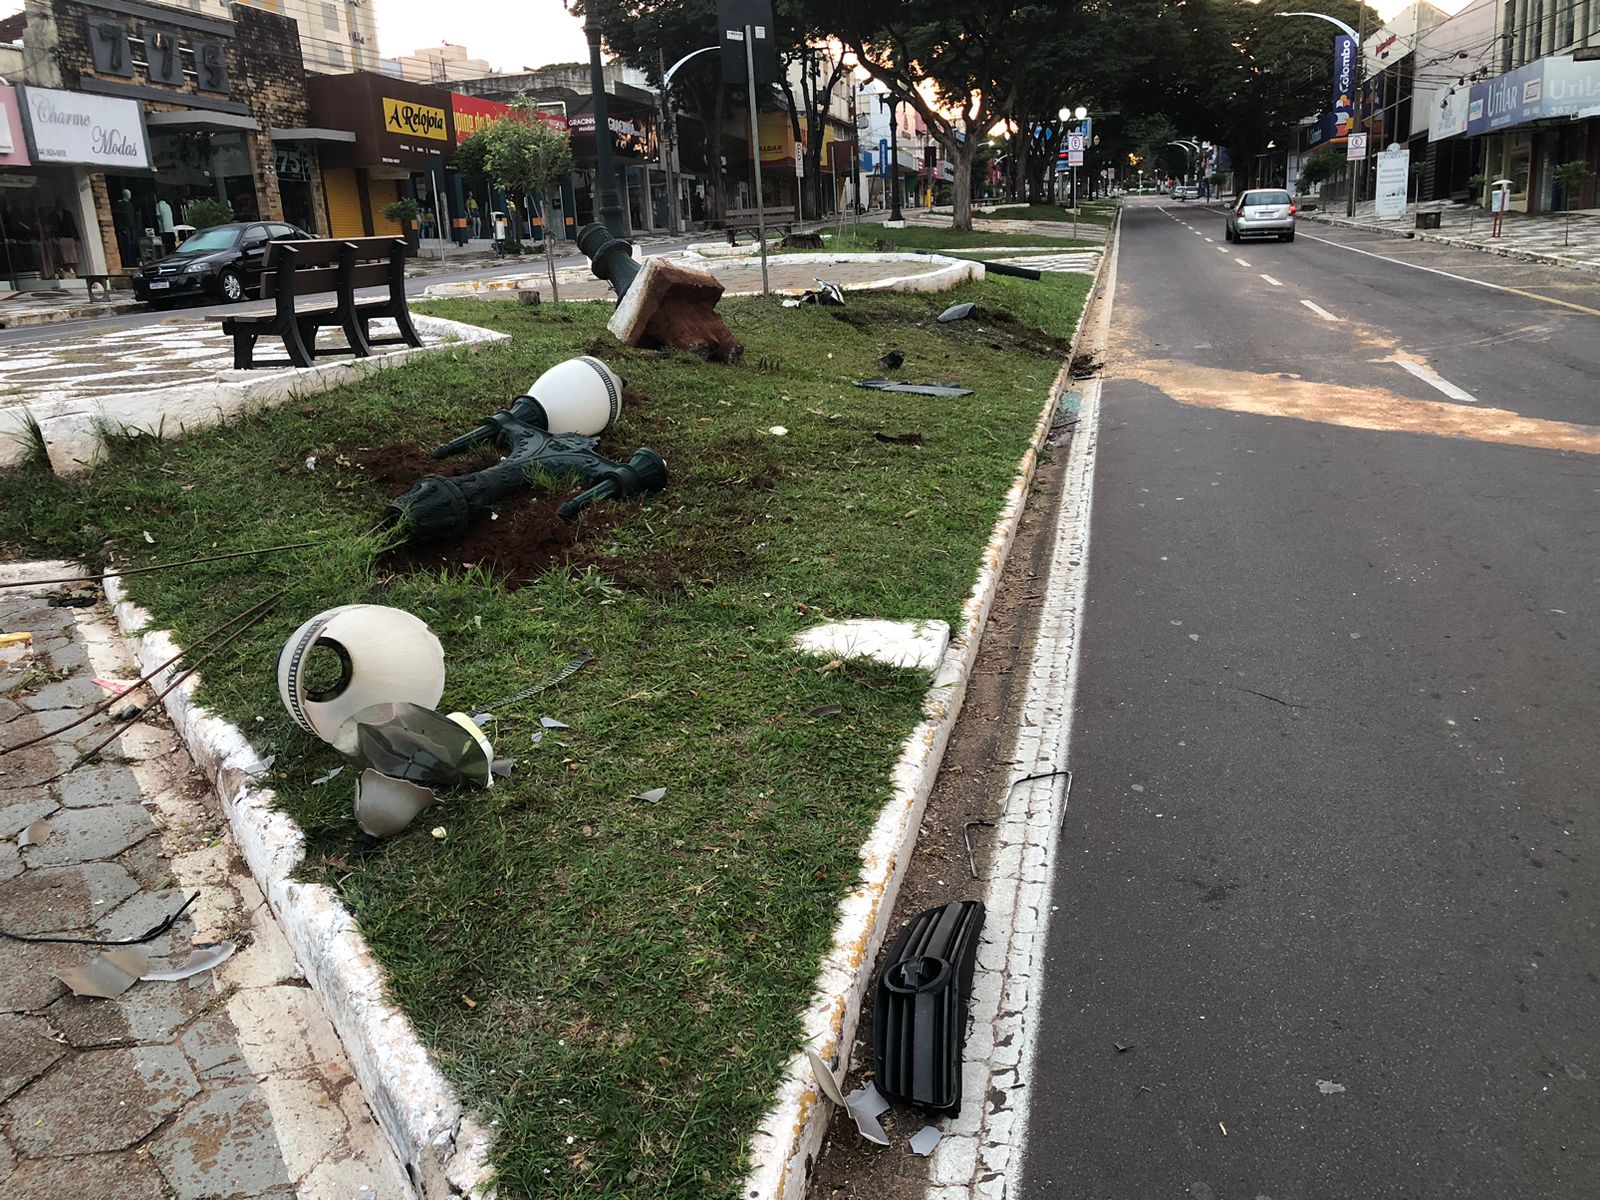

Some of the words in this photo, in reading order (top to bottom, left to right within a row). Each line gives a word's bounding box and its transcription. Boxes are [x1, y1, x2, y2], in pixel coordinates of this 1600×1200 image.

[1338, 39, 1351, 93] Colombo
[31, 94, 91, 126] Charme
[389, 104, 402, 128] A
[402, 106, 443, 134] Relojoia
[92, 126, 138, 157] Modas
